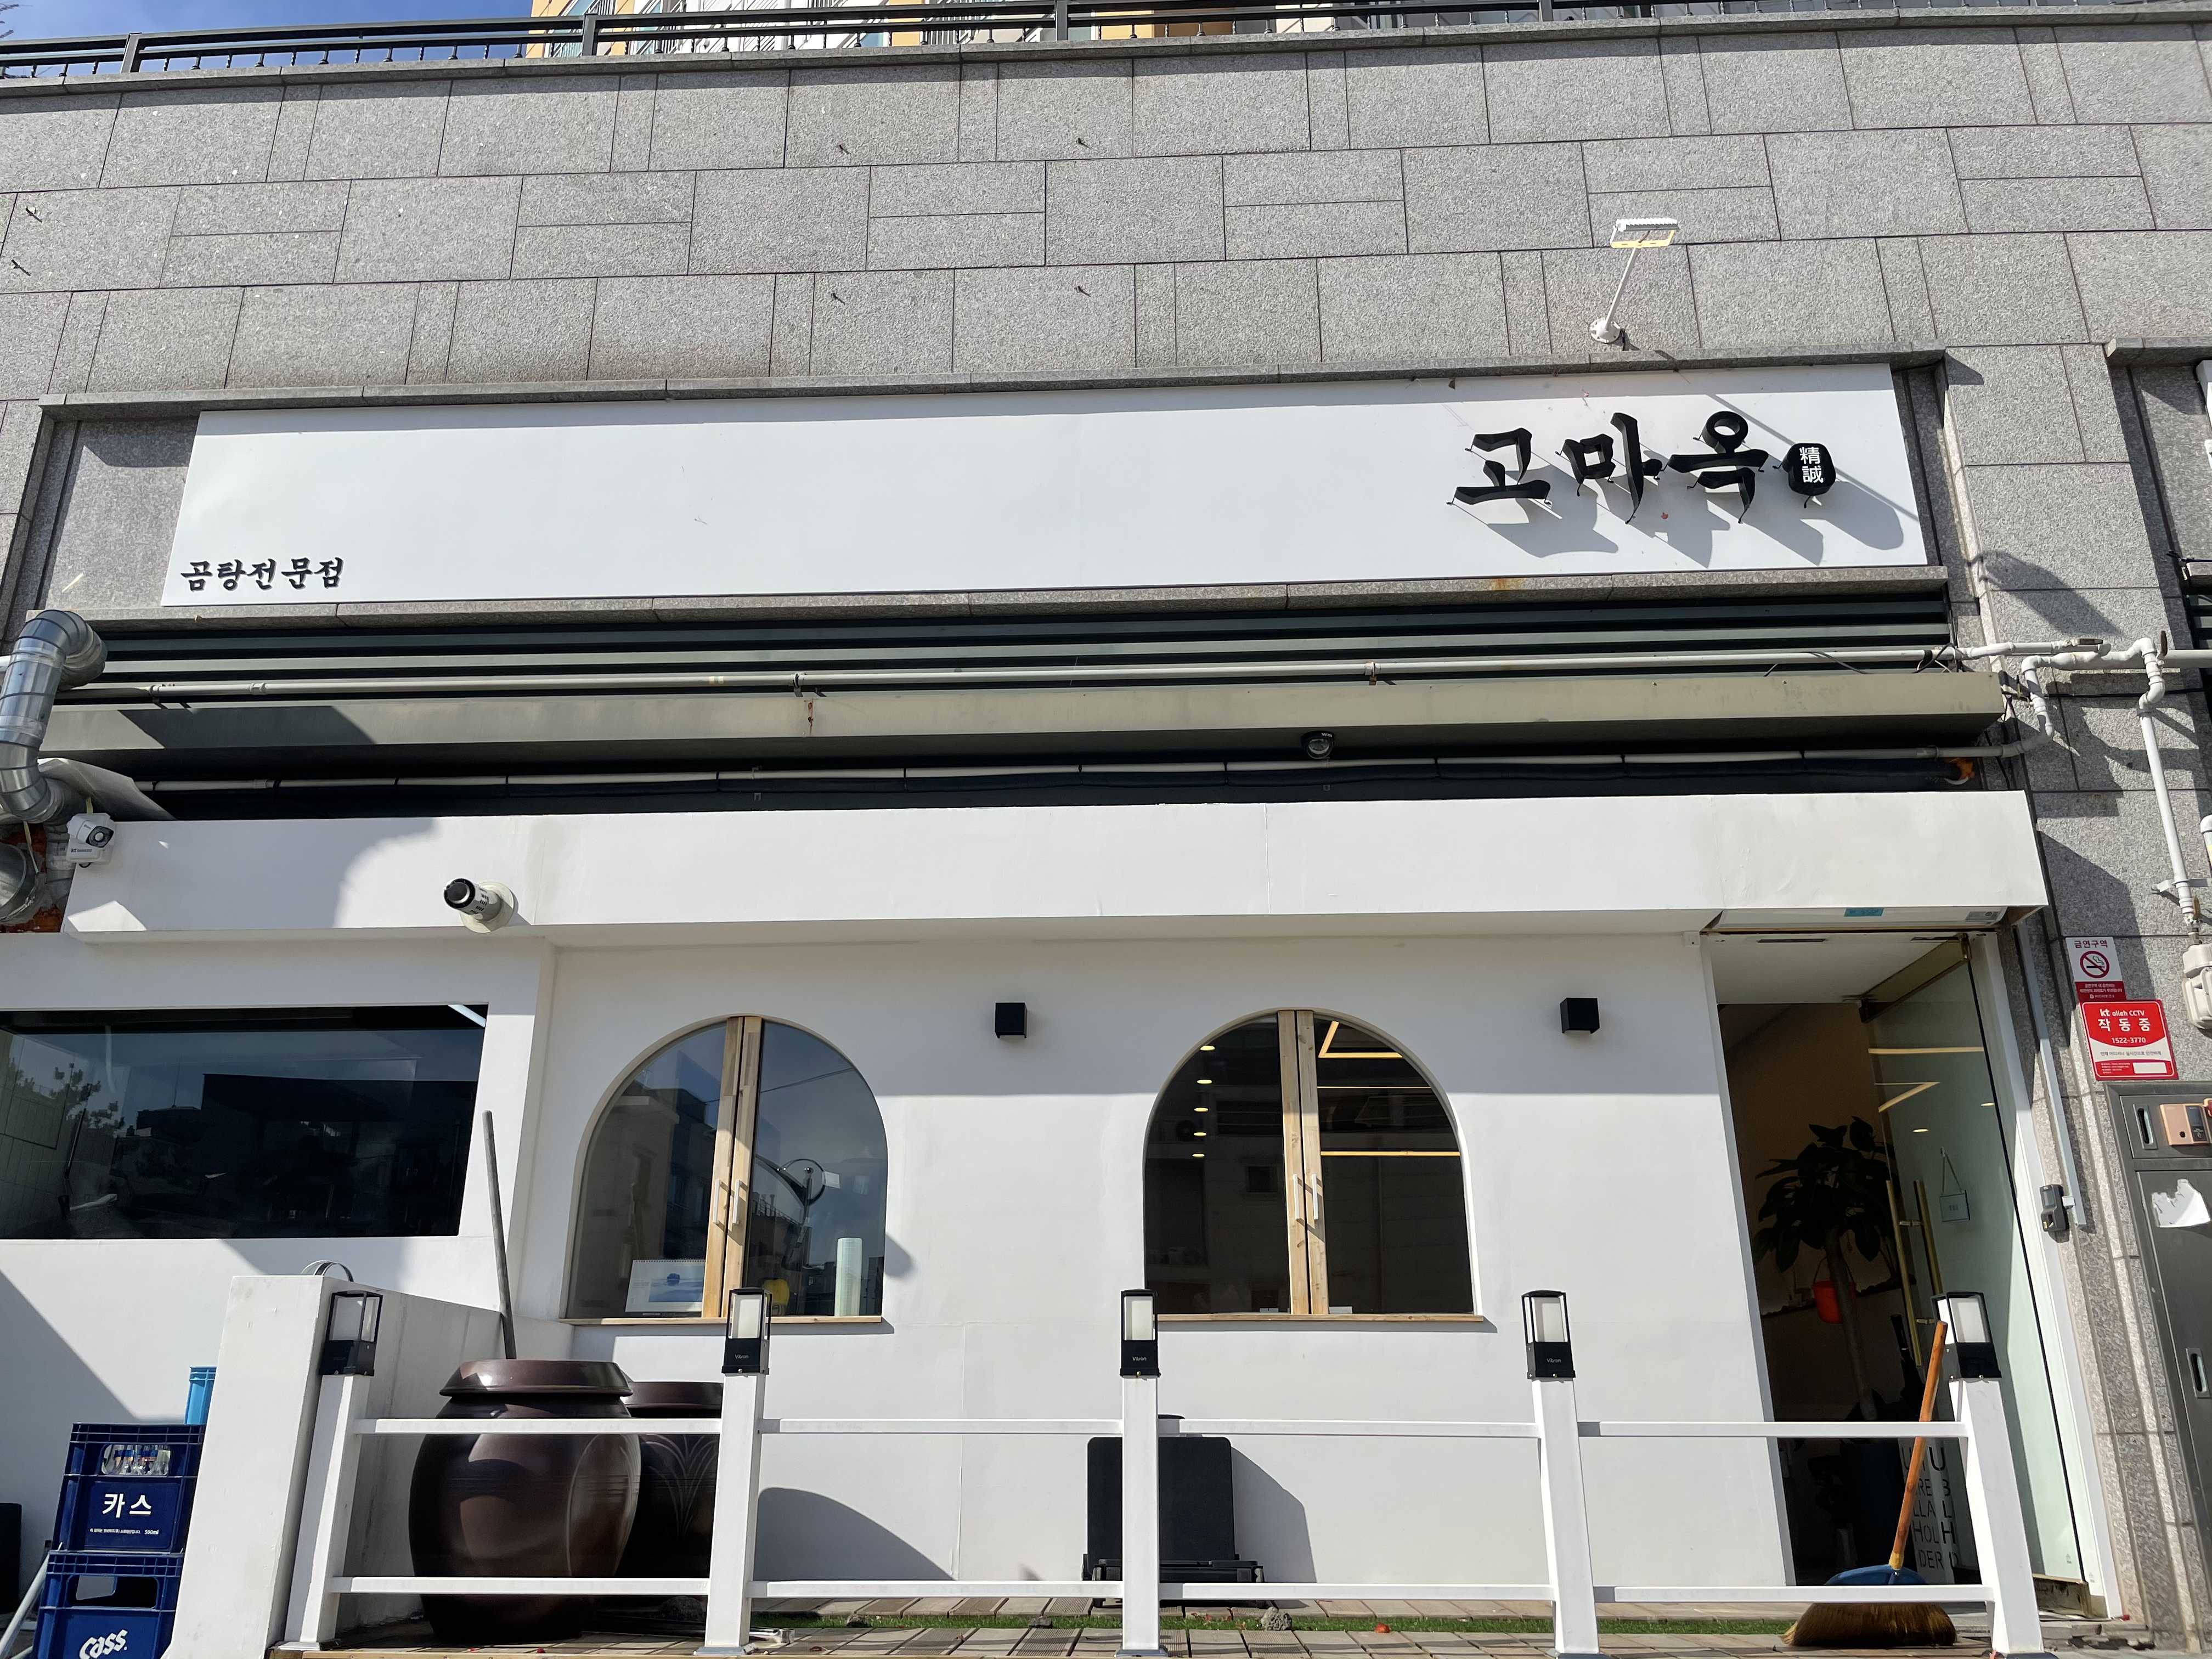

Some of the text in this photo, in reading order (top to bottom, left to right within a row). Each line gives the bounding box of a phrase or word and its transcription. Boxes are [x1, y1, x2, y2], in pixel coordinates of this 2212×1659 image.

[1453, 410, 1769, 520] 고마옥
[1799, 446, 1824, 483] 精誠
[180, 557, 343, 591] 곰탕전문점
[2074, 940, 2108, 949] 금연구역
[2099, 1008, 2111, 1017] kt
